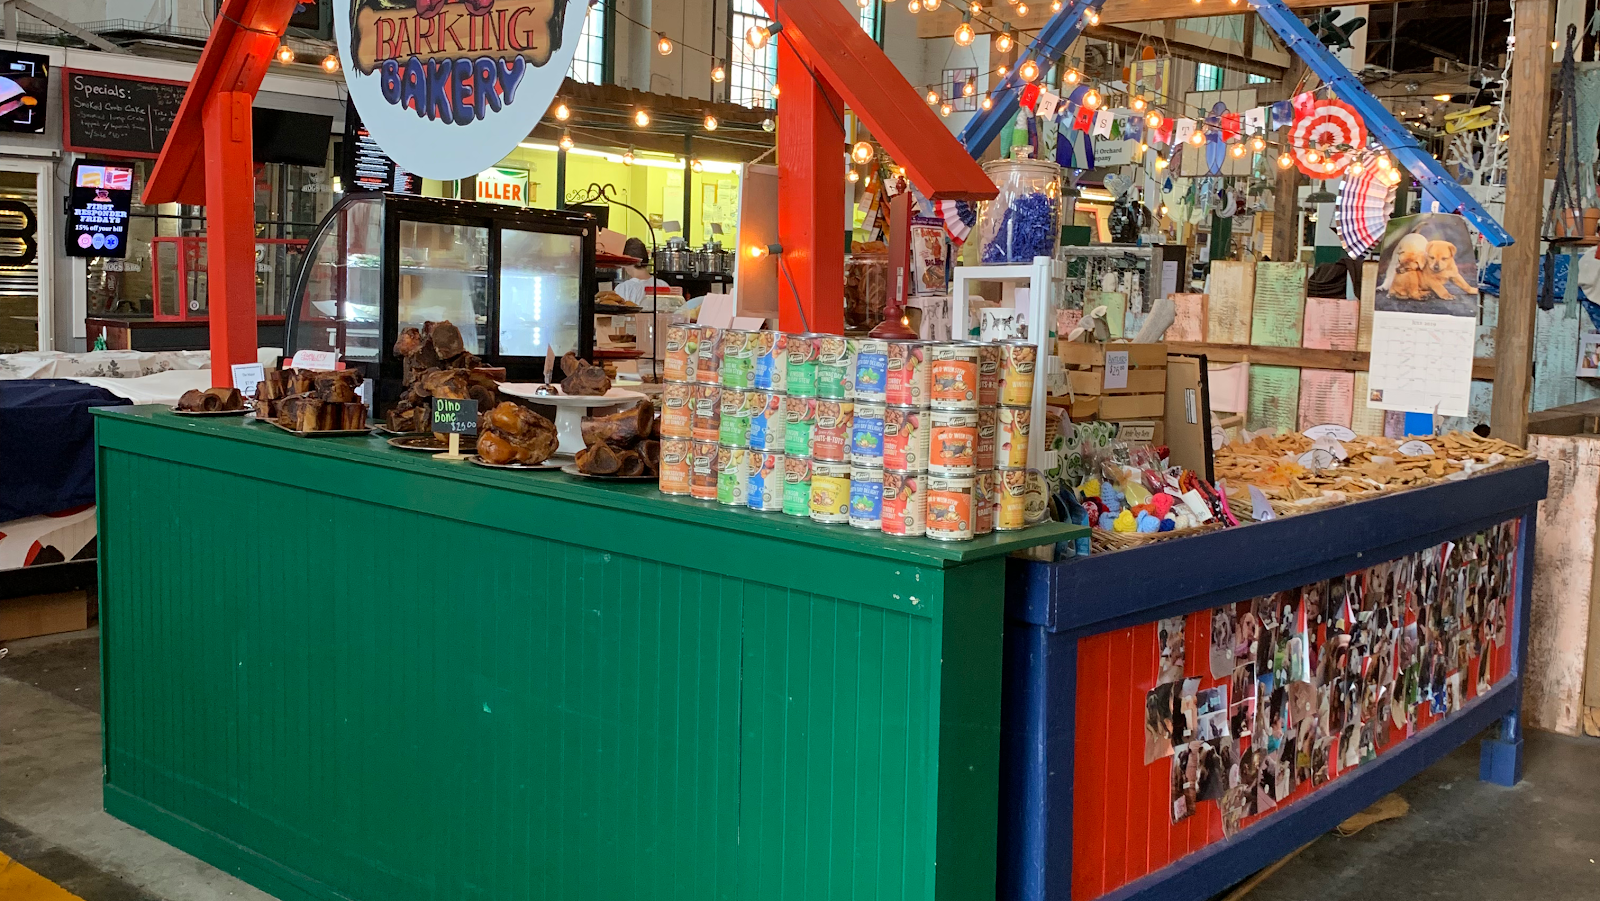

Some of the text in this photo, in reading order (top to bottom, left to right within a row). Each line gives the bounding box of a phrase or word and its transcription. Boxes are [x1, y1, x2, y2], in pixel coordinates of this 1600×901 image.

[374, 6, 538, 62] BARKING
[74, 76, 131, 99] Specials:
[380, 54, 527, 126] BAKERY
[74, 208, 127, 218] RESPONDER
[86, 203, 114, 211] FIRST
[80, 215, 121, 224] FRIDAYS
[112, 225, 123, 233] bill
[437, 399, 461, 412] Dino
[434, 411, 456, 423] Bone
